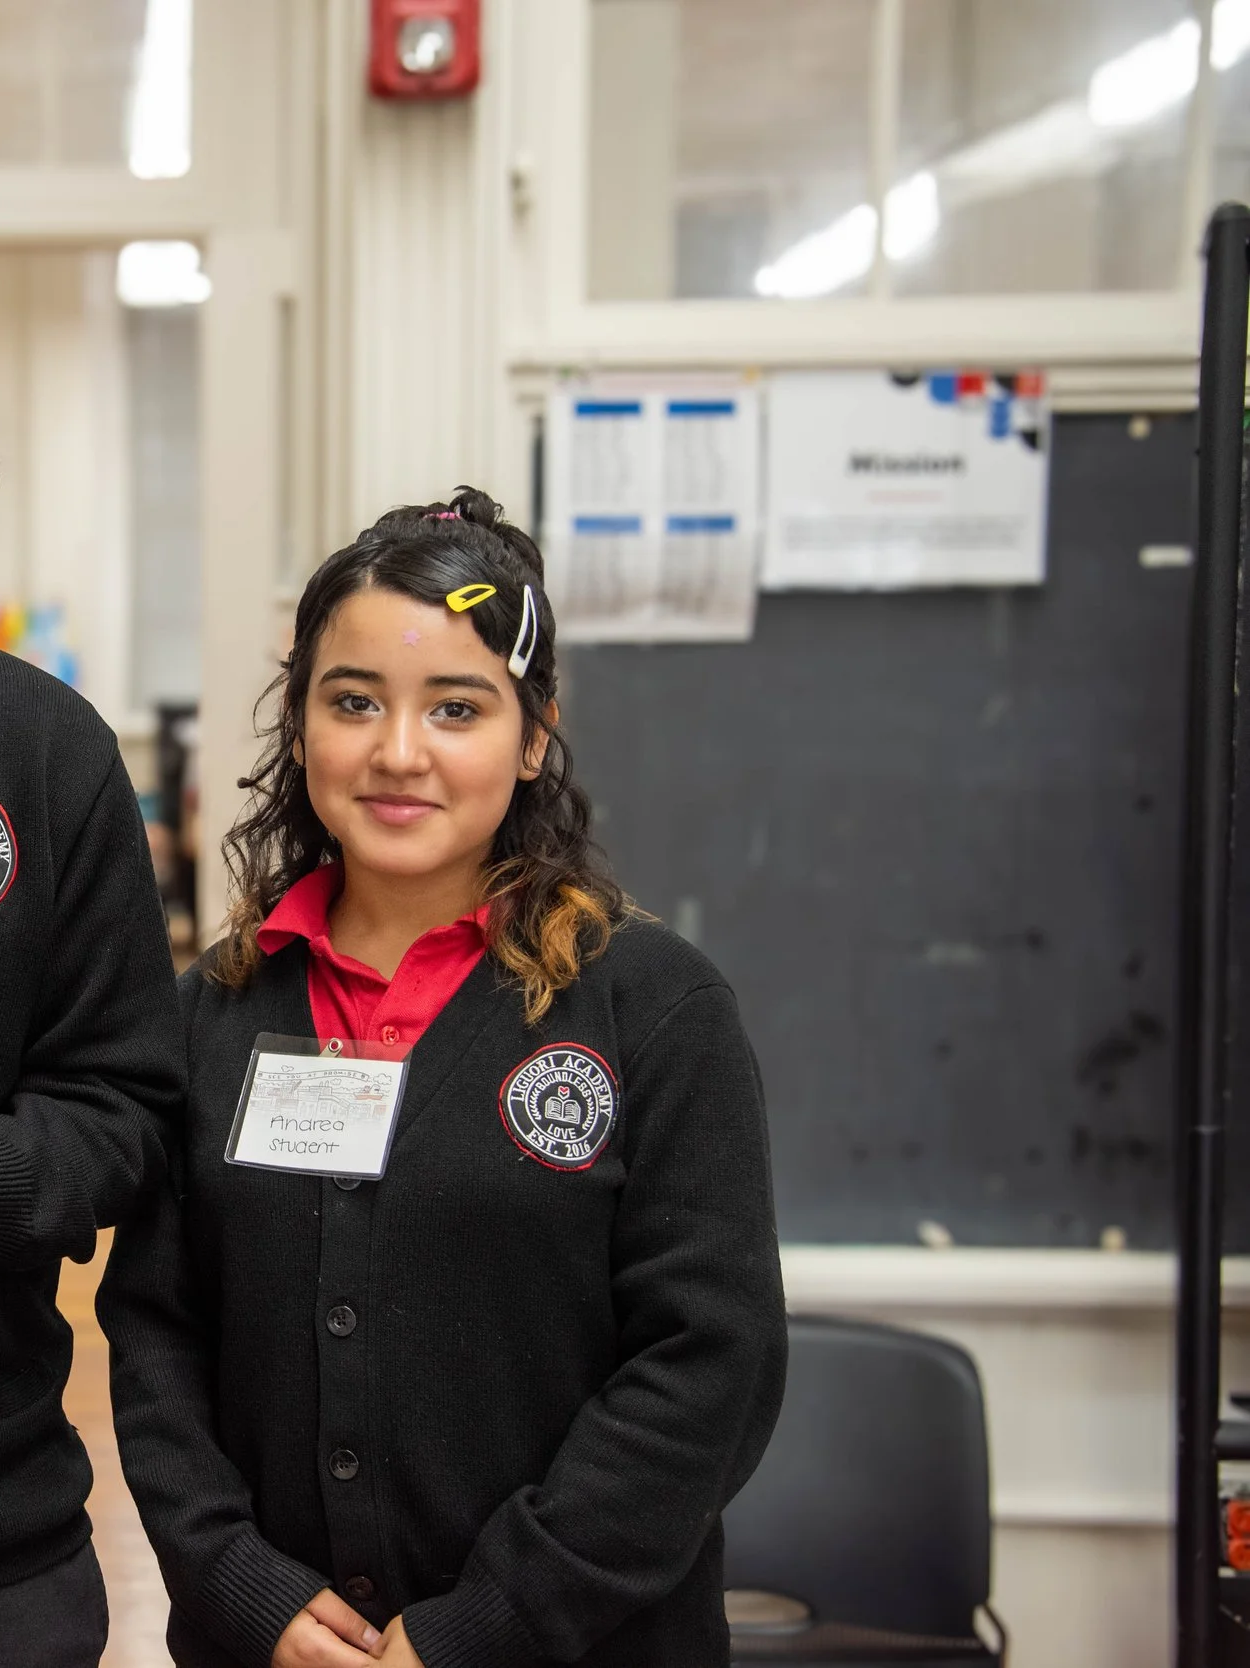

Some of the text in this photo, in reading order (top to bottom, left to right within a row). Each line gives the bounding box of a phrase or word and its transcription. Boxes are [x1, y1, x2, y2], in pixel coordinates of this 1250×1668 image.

[511, 1055, 611, 1117] LIGUORI ACADEMY
[535, 1071, 592, 1097] BOUNDLESS
[270, 1115, 345, 1131] Andrea
[547, 1123, 577, 1139] LOVE
[526, 1128, 590, 1157] EST. 2016
